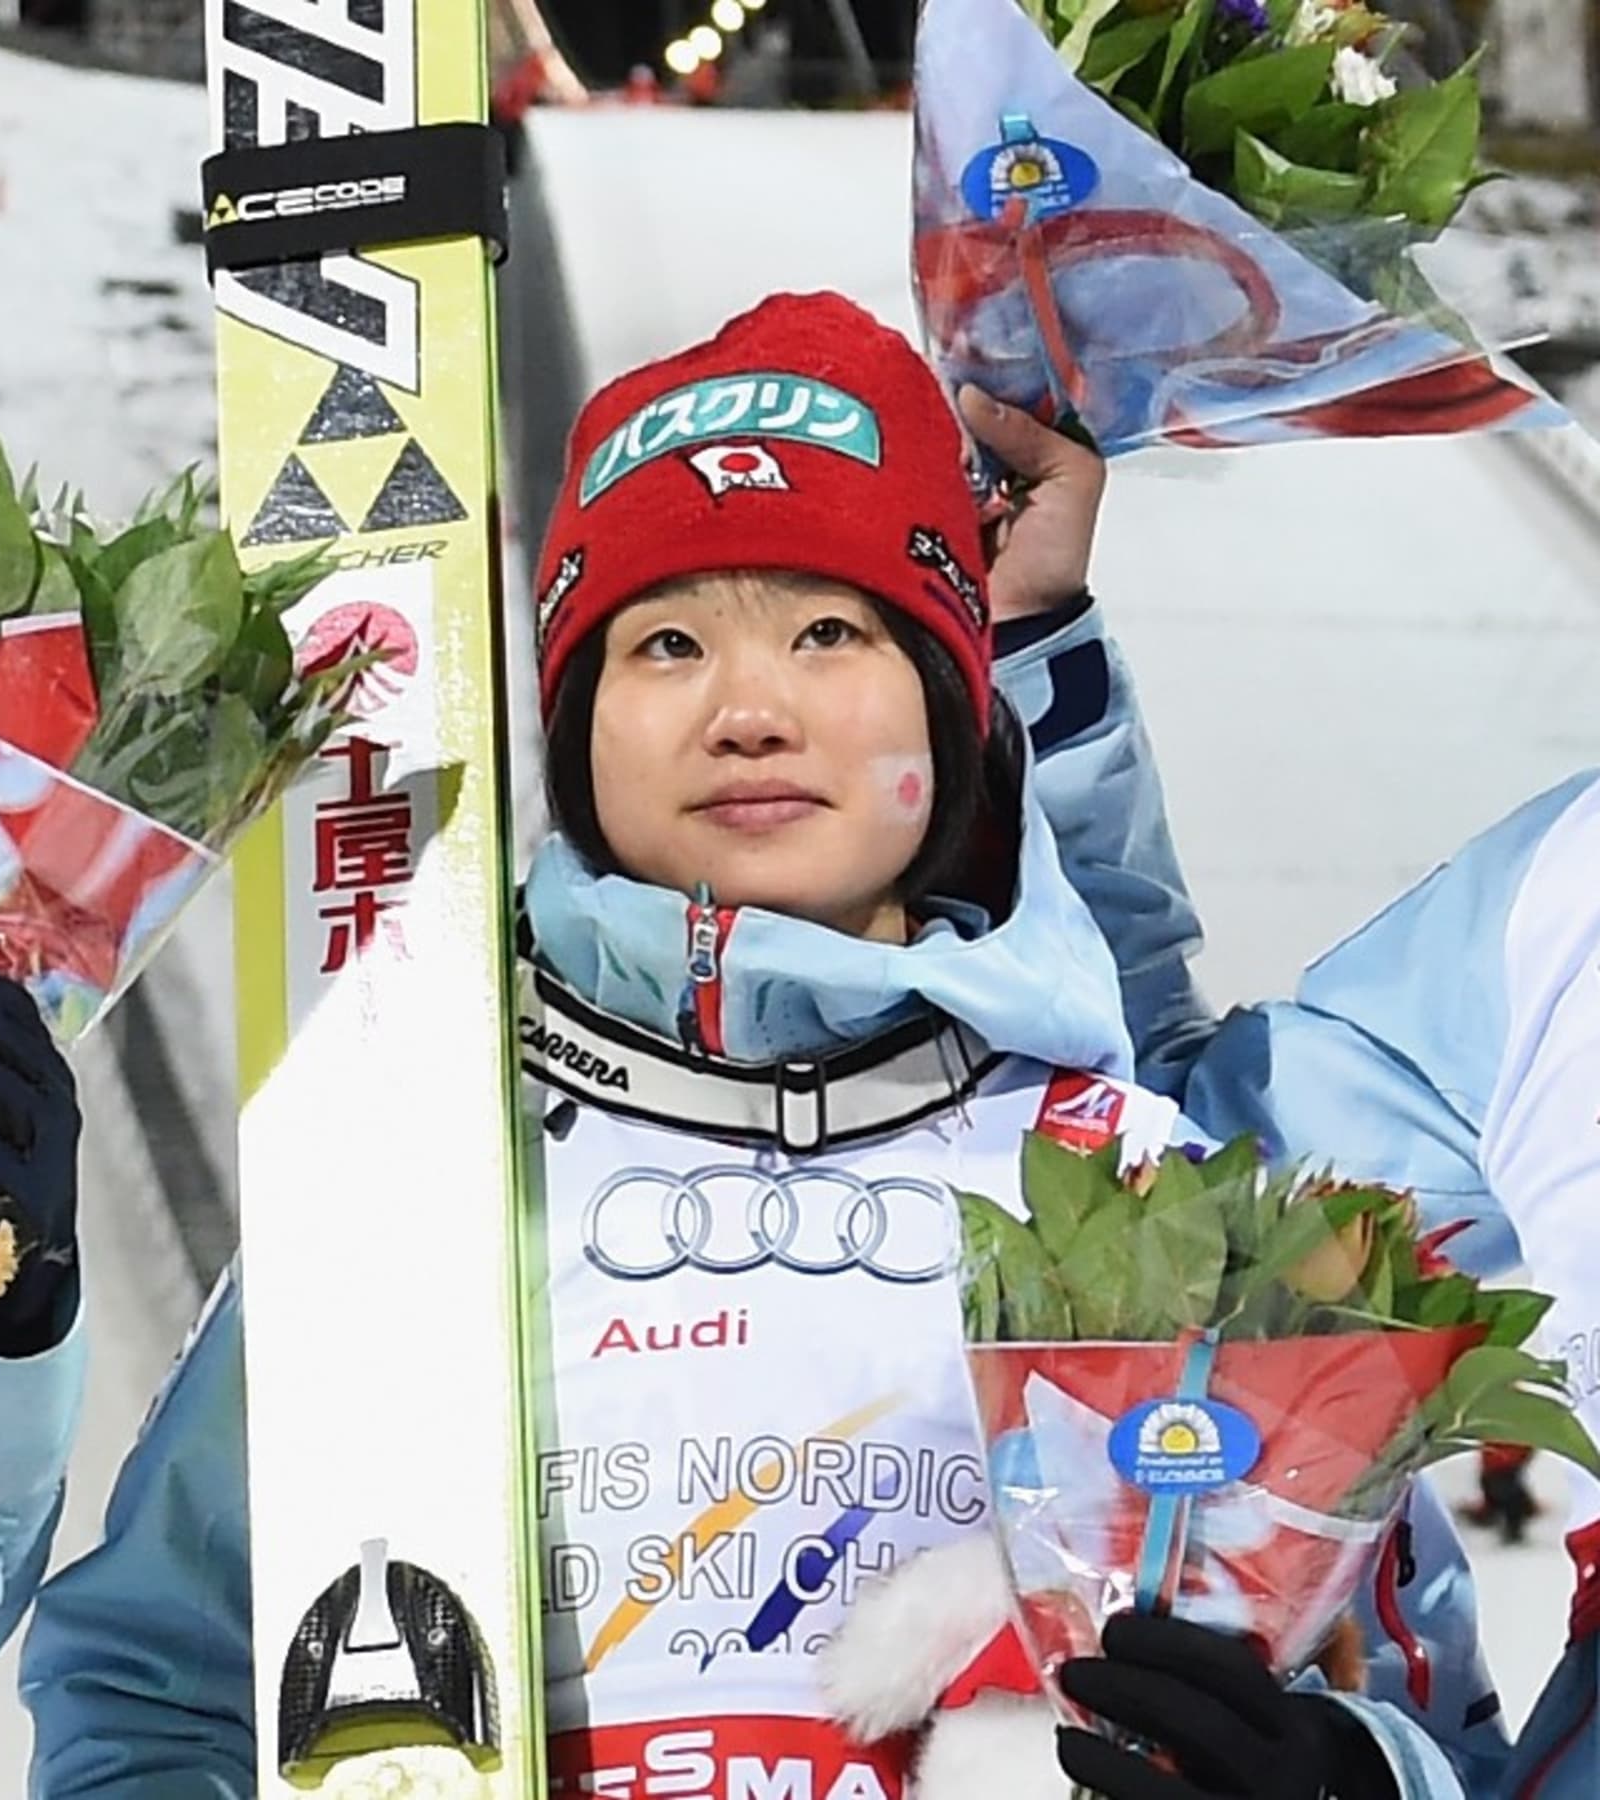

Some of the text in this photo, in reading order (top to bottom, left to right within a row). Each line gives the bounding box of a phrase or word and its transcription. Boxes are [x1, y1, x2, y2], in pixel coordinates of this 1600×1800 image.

[597, 380, 861, 478] バスクリン
[334, 539, 450, 572] CHER
[517, 1014, 630, 1093] CARRERA
[590, 1308, 749, 1358] Audi
[536, 1435, 987, 1526] FIS NORDIC
[624, 1531, 757, 1605] SKI
